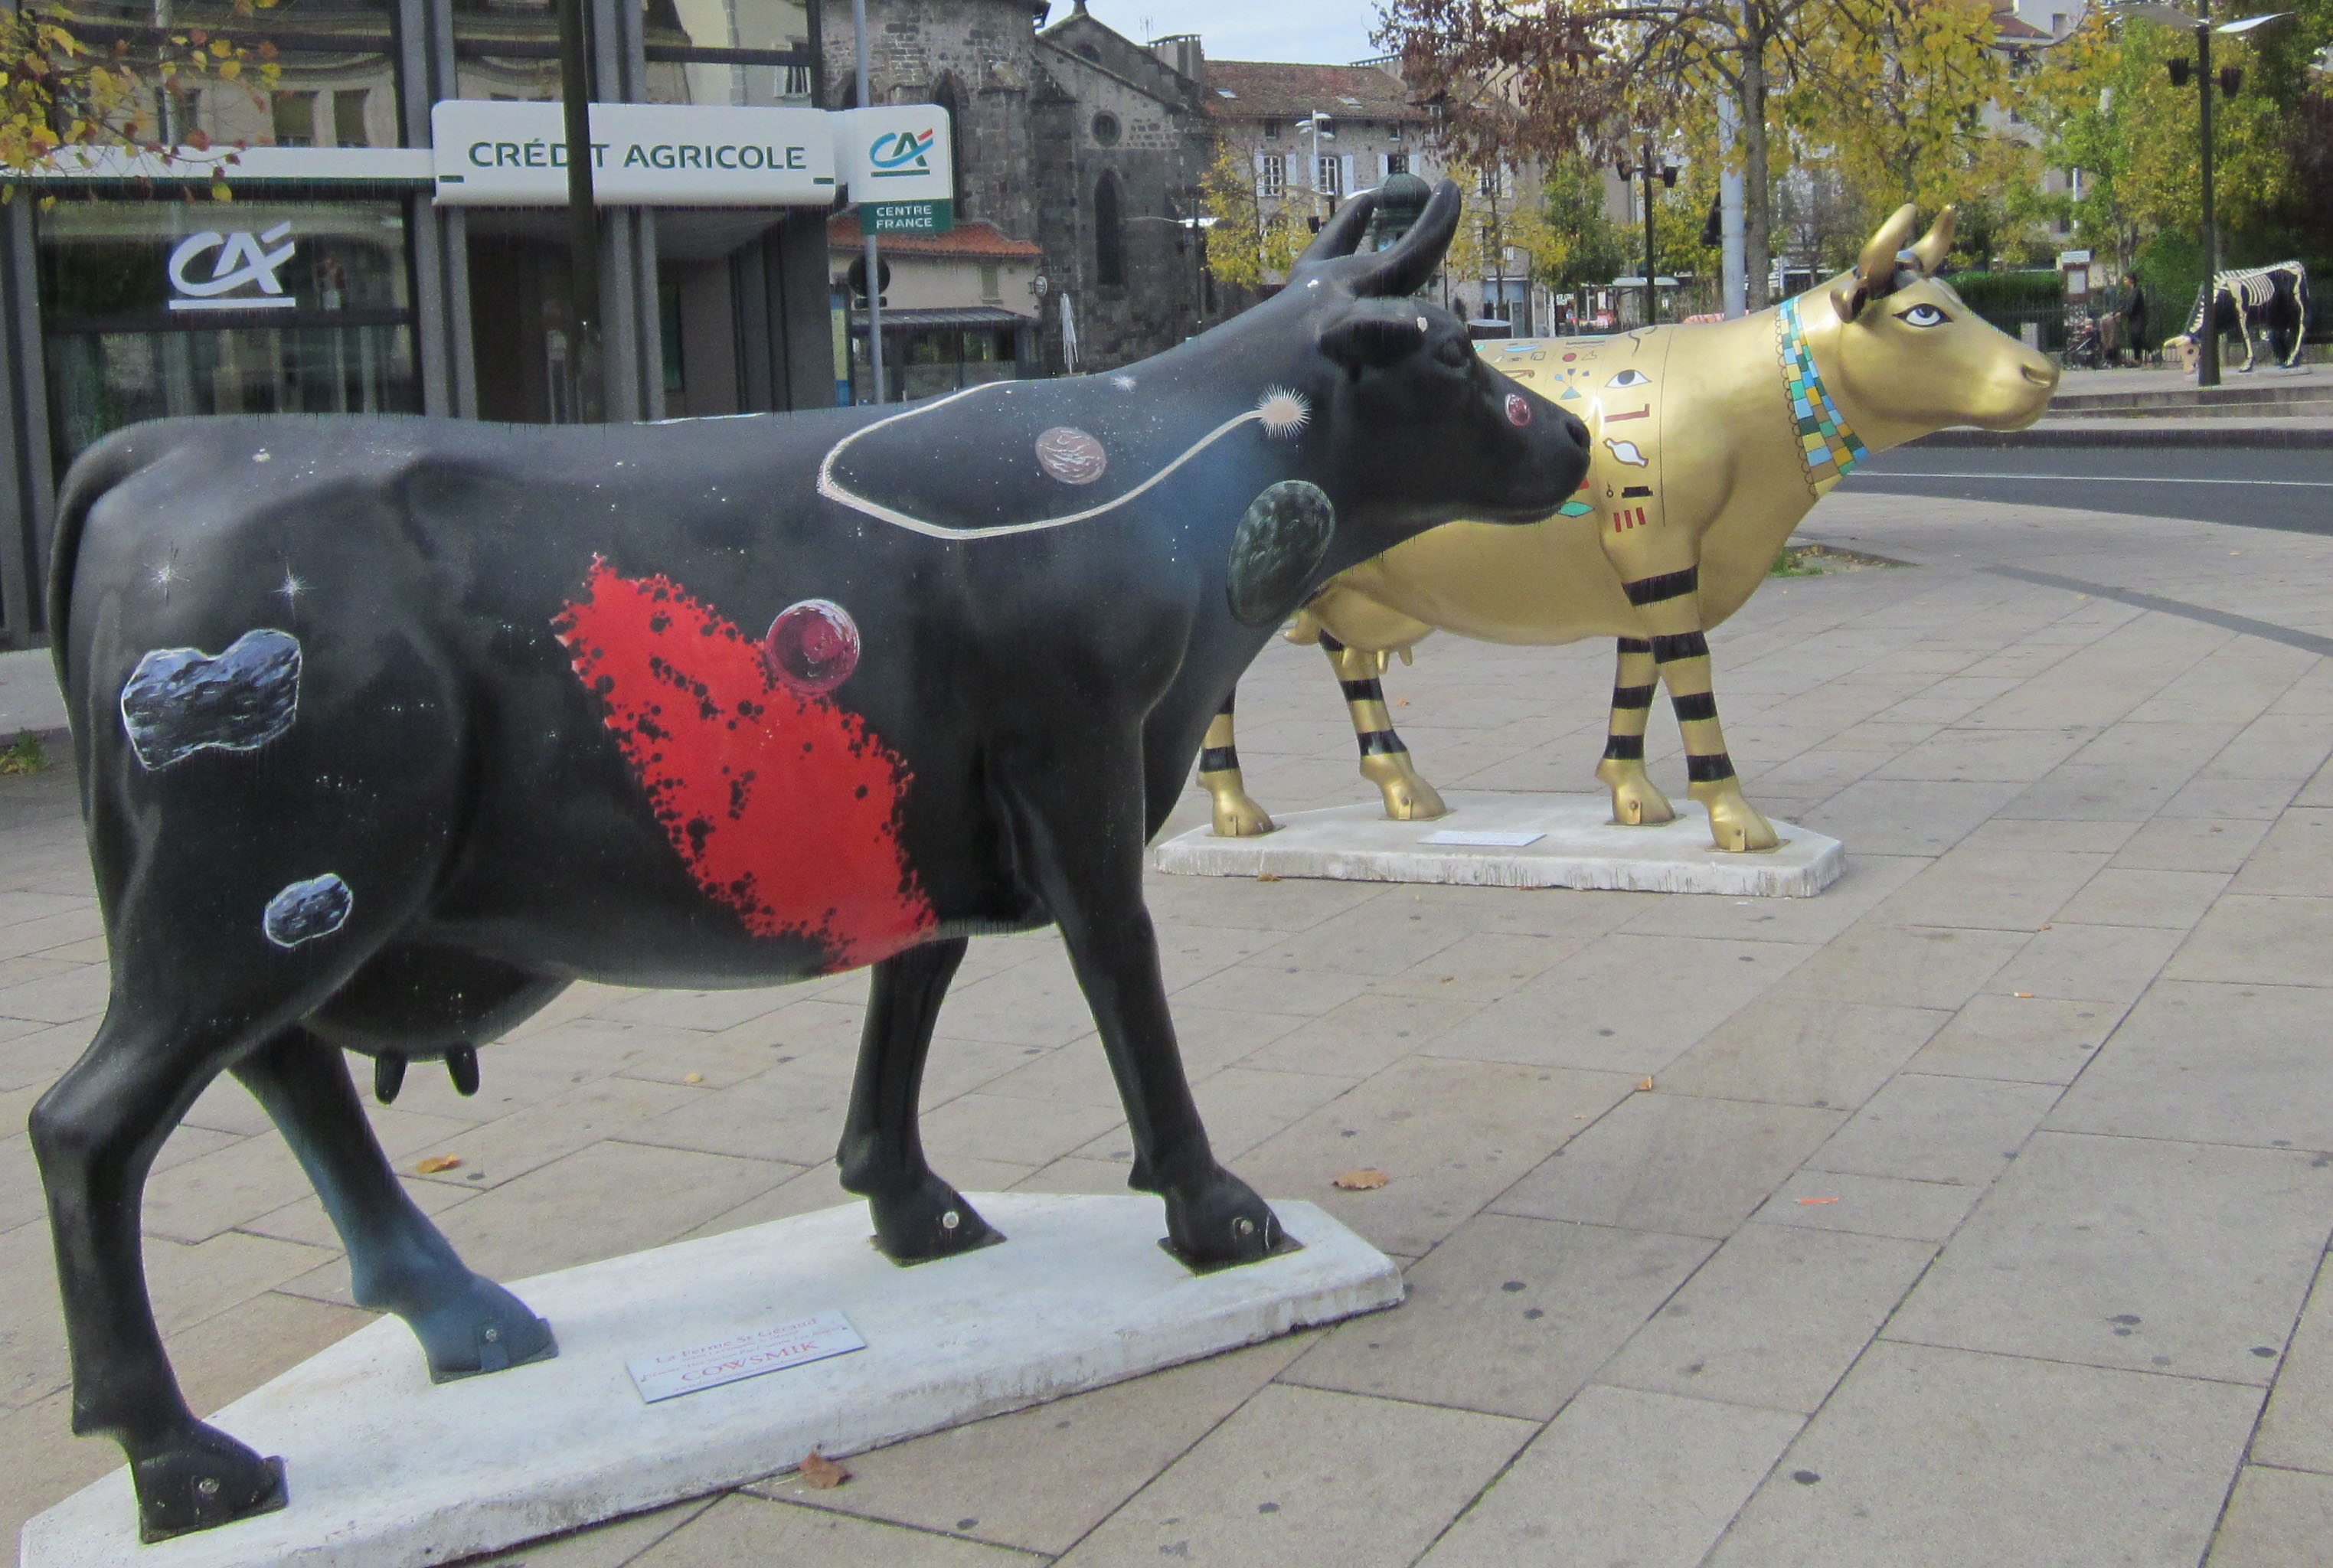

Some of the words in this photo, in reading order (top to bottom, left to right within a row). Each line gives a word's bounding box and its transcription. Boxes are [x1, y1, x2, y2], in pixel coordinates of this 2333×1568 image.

[469, 138, 610, 168] CRÉDT
[623, 144, 807, 169] AGRICOLE
[876, 205, 932, 217] CENTRE
[876, 217, 933, 229] FRANCE
[681, 1341, 819, 1381] COWSMIK
